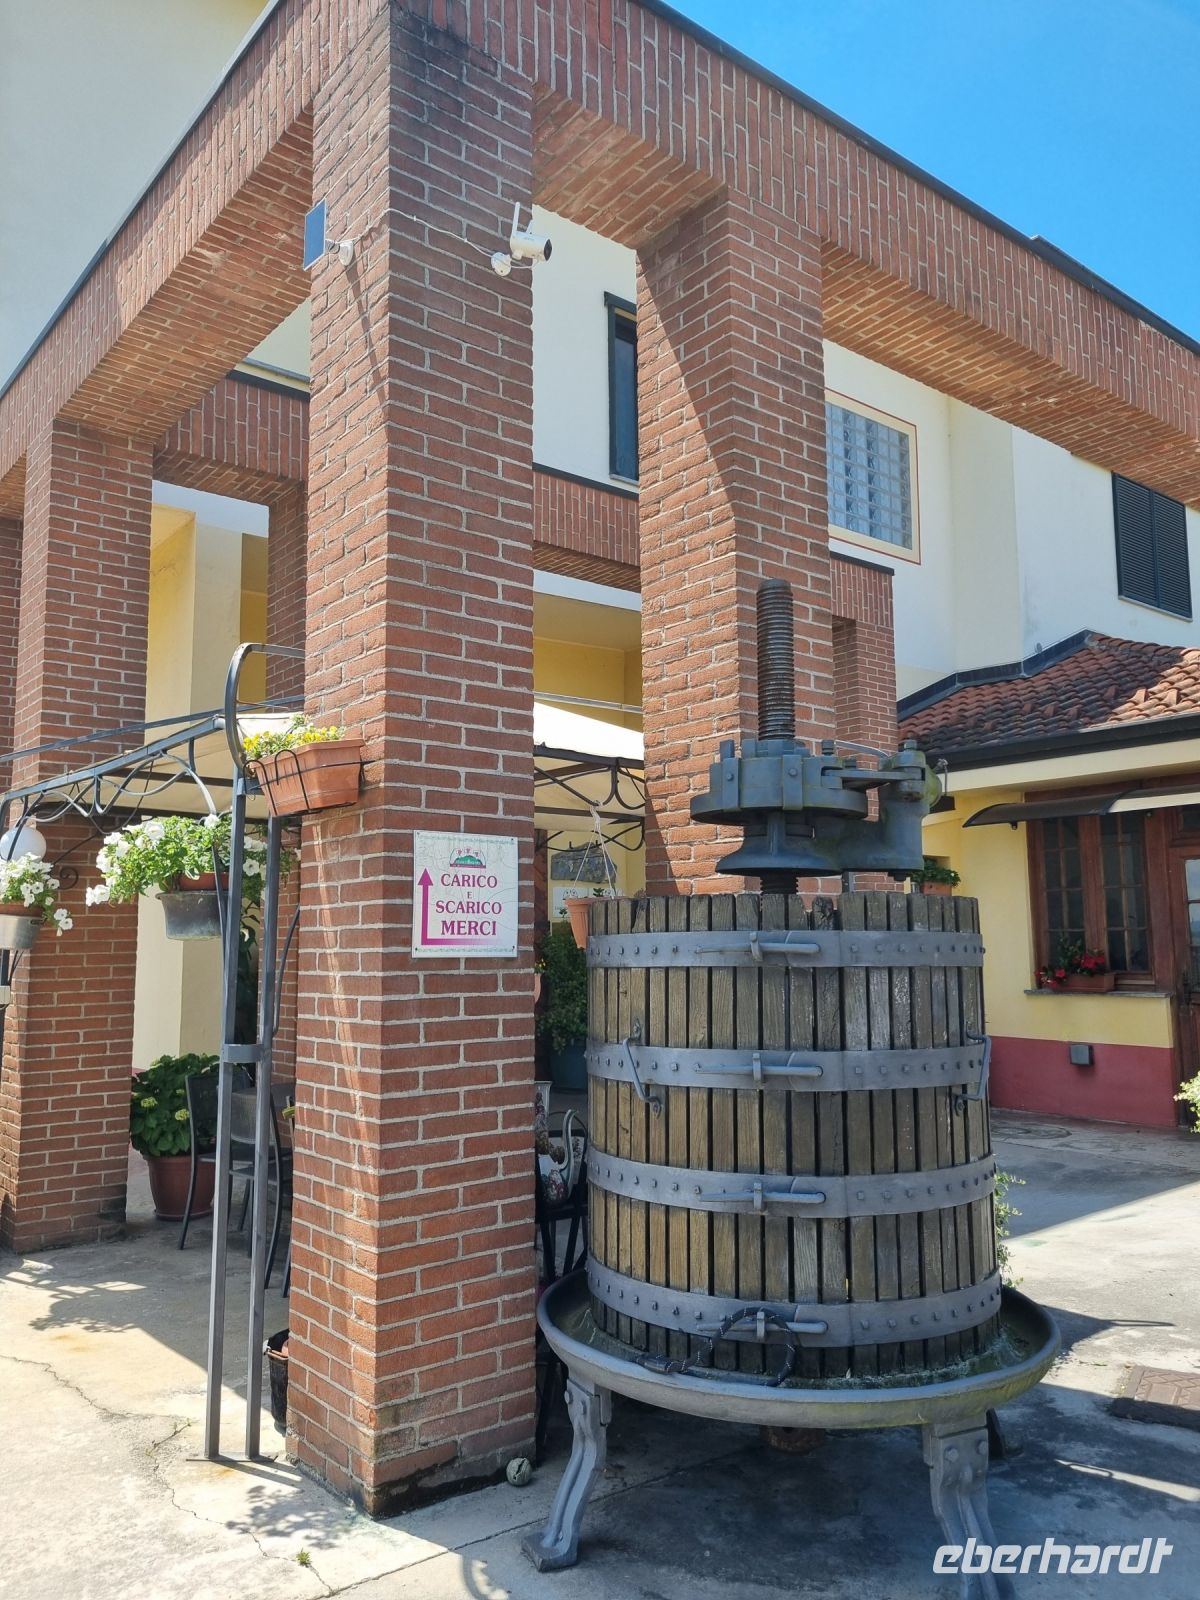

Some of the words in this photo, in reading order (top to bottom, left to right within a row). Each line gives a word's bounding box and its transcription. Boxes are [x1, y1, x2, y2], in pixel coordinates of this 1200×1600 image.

[440, 873, 498, 888] CARICO
[467, 891, 472, 899] E
[435, 900, 502, 915] SCARICO
[441, 920, 497, 936] MERCI
